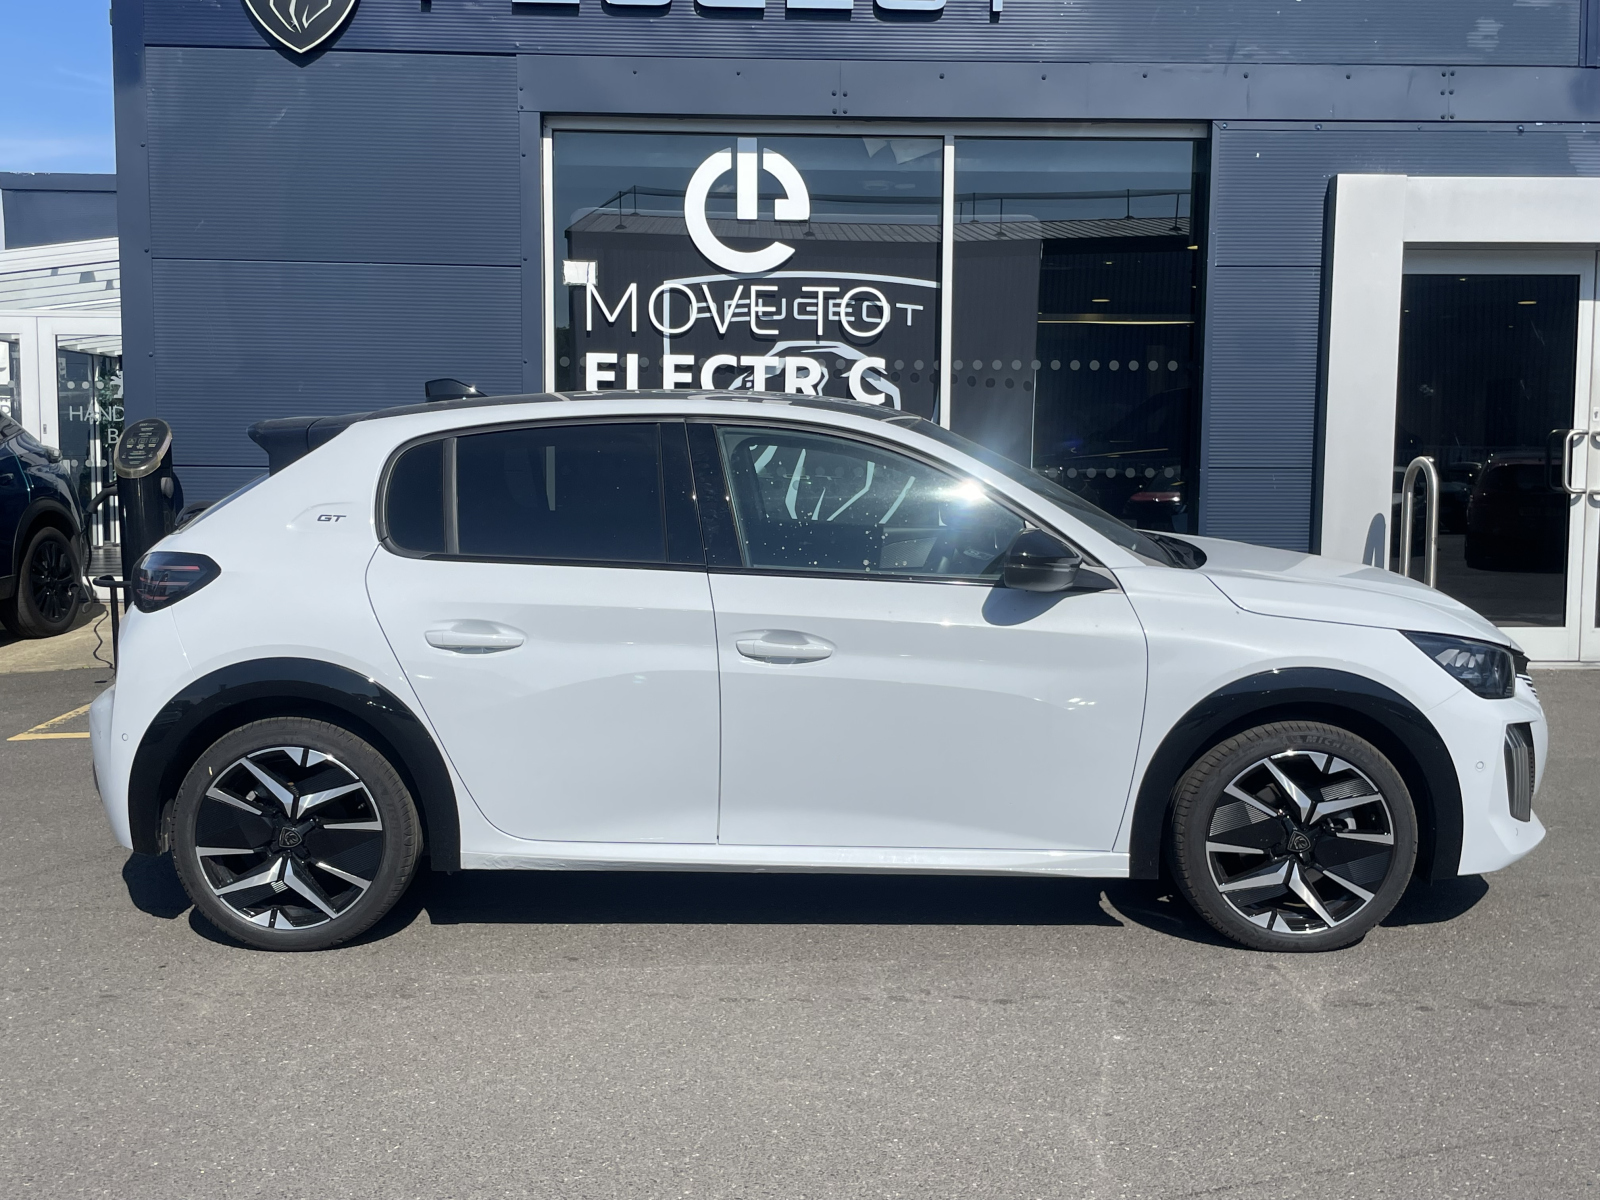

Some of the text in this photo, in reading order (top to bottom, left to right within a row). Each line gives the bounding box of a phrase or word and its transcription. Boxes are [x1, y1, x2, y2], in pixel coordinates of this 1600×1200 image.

[585, 282, 891, 338] MOVE TO
[317, 514, 347, 522] GT
